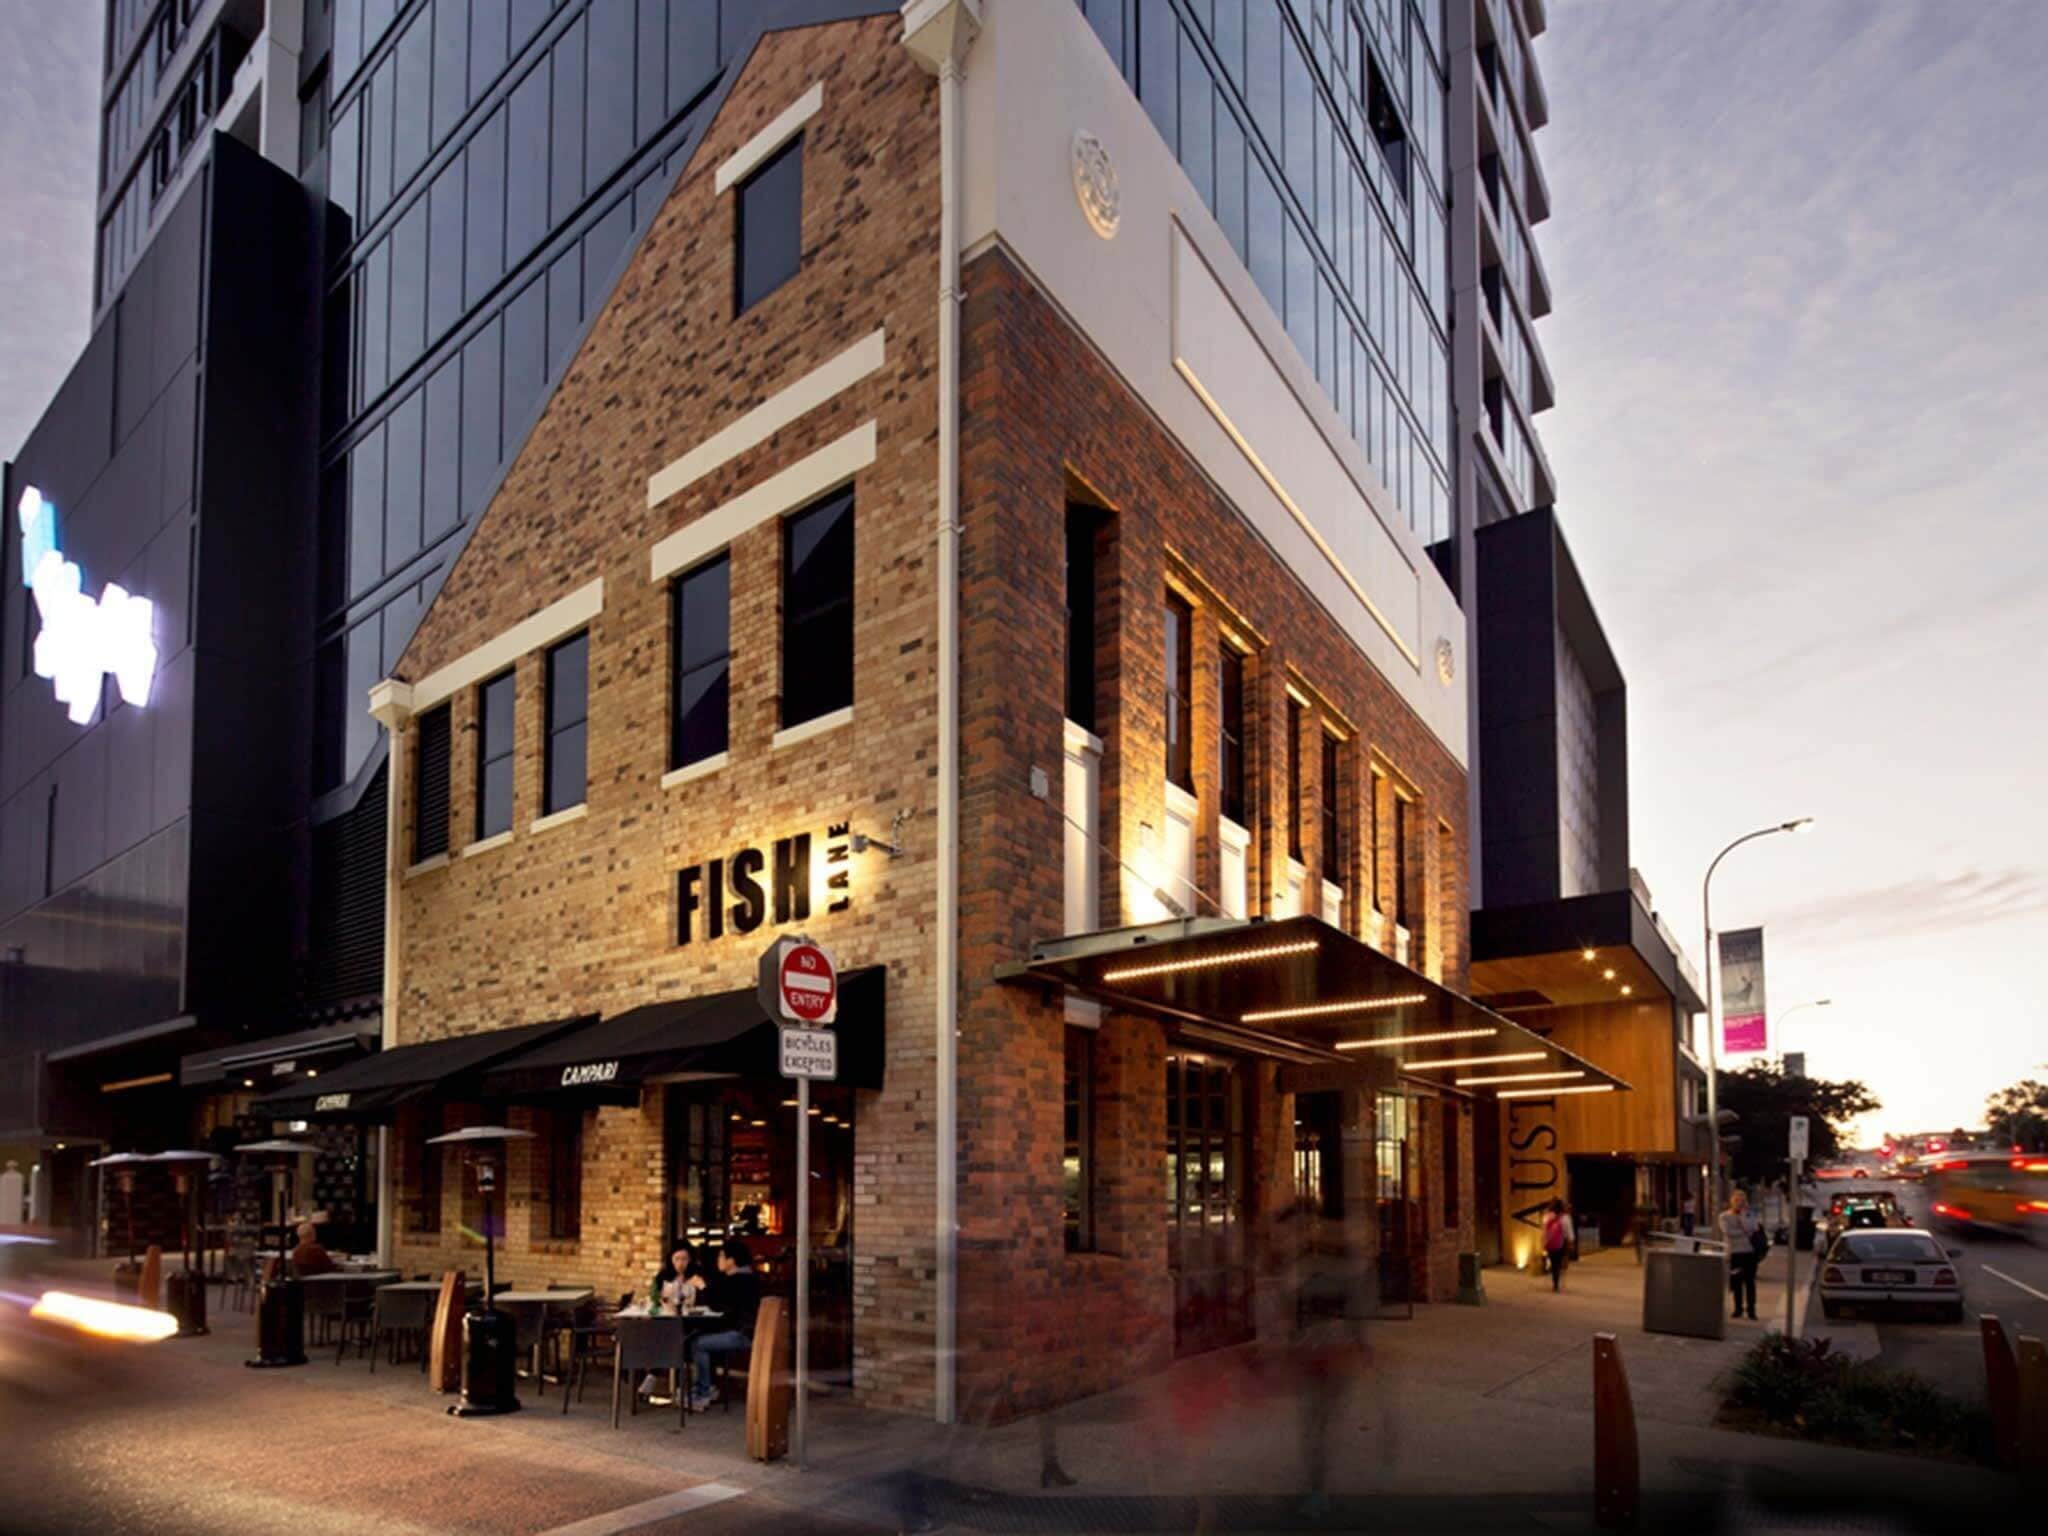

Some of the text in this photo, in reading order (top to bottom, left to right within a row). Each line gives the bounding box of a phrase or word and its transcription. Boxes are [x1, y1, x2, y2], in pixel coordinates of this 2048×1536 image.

[827, 821, 849, 915] LANE
[676, 832, 811, 947] FISH
[800, 955, 817, 969] NO
[790, 991, 826, 1009] ENTRY
[785, 1037, 832, 1054] BICYCLES
[785, 1056, 833, 1071] EXCEPTED
[561, 1061, 619, 1086] CAMPARI
